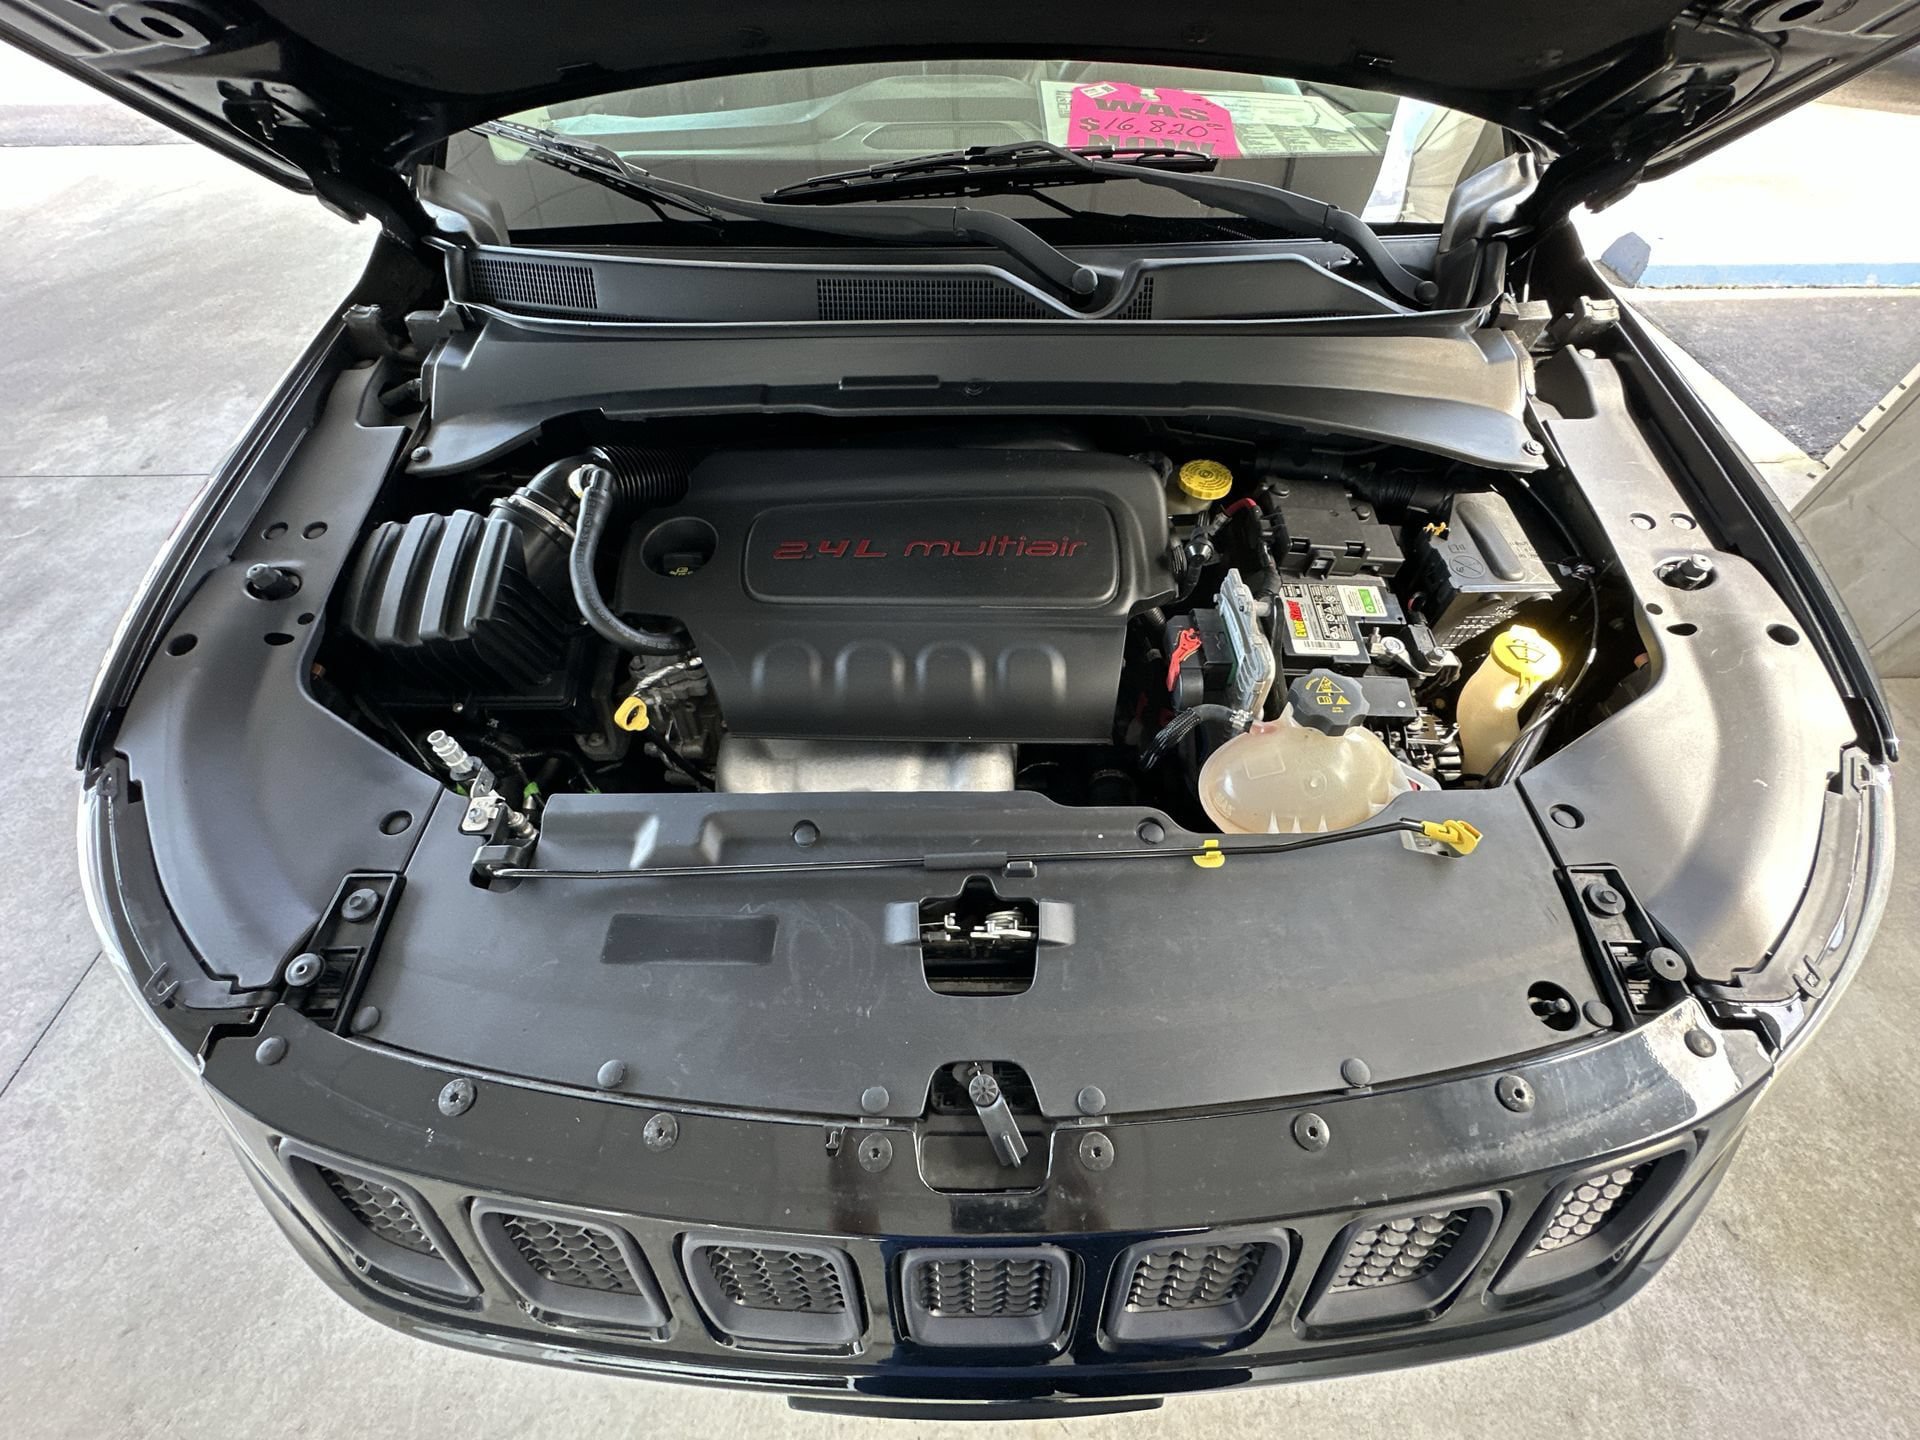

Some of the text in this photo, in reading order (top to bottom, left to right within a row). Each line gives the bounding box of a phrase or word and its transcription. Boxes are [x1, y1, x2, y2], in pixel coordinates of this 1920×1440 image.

[1094, 98, 1210, 121] WAS
[773, 534, 1088, 561] 2.4L multiair
